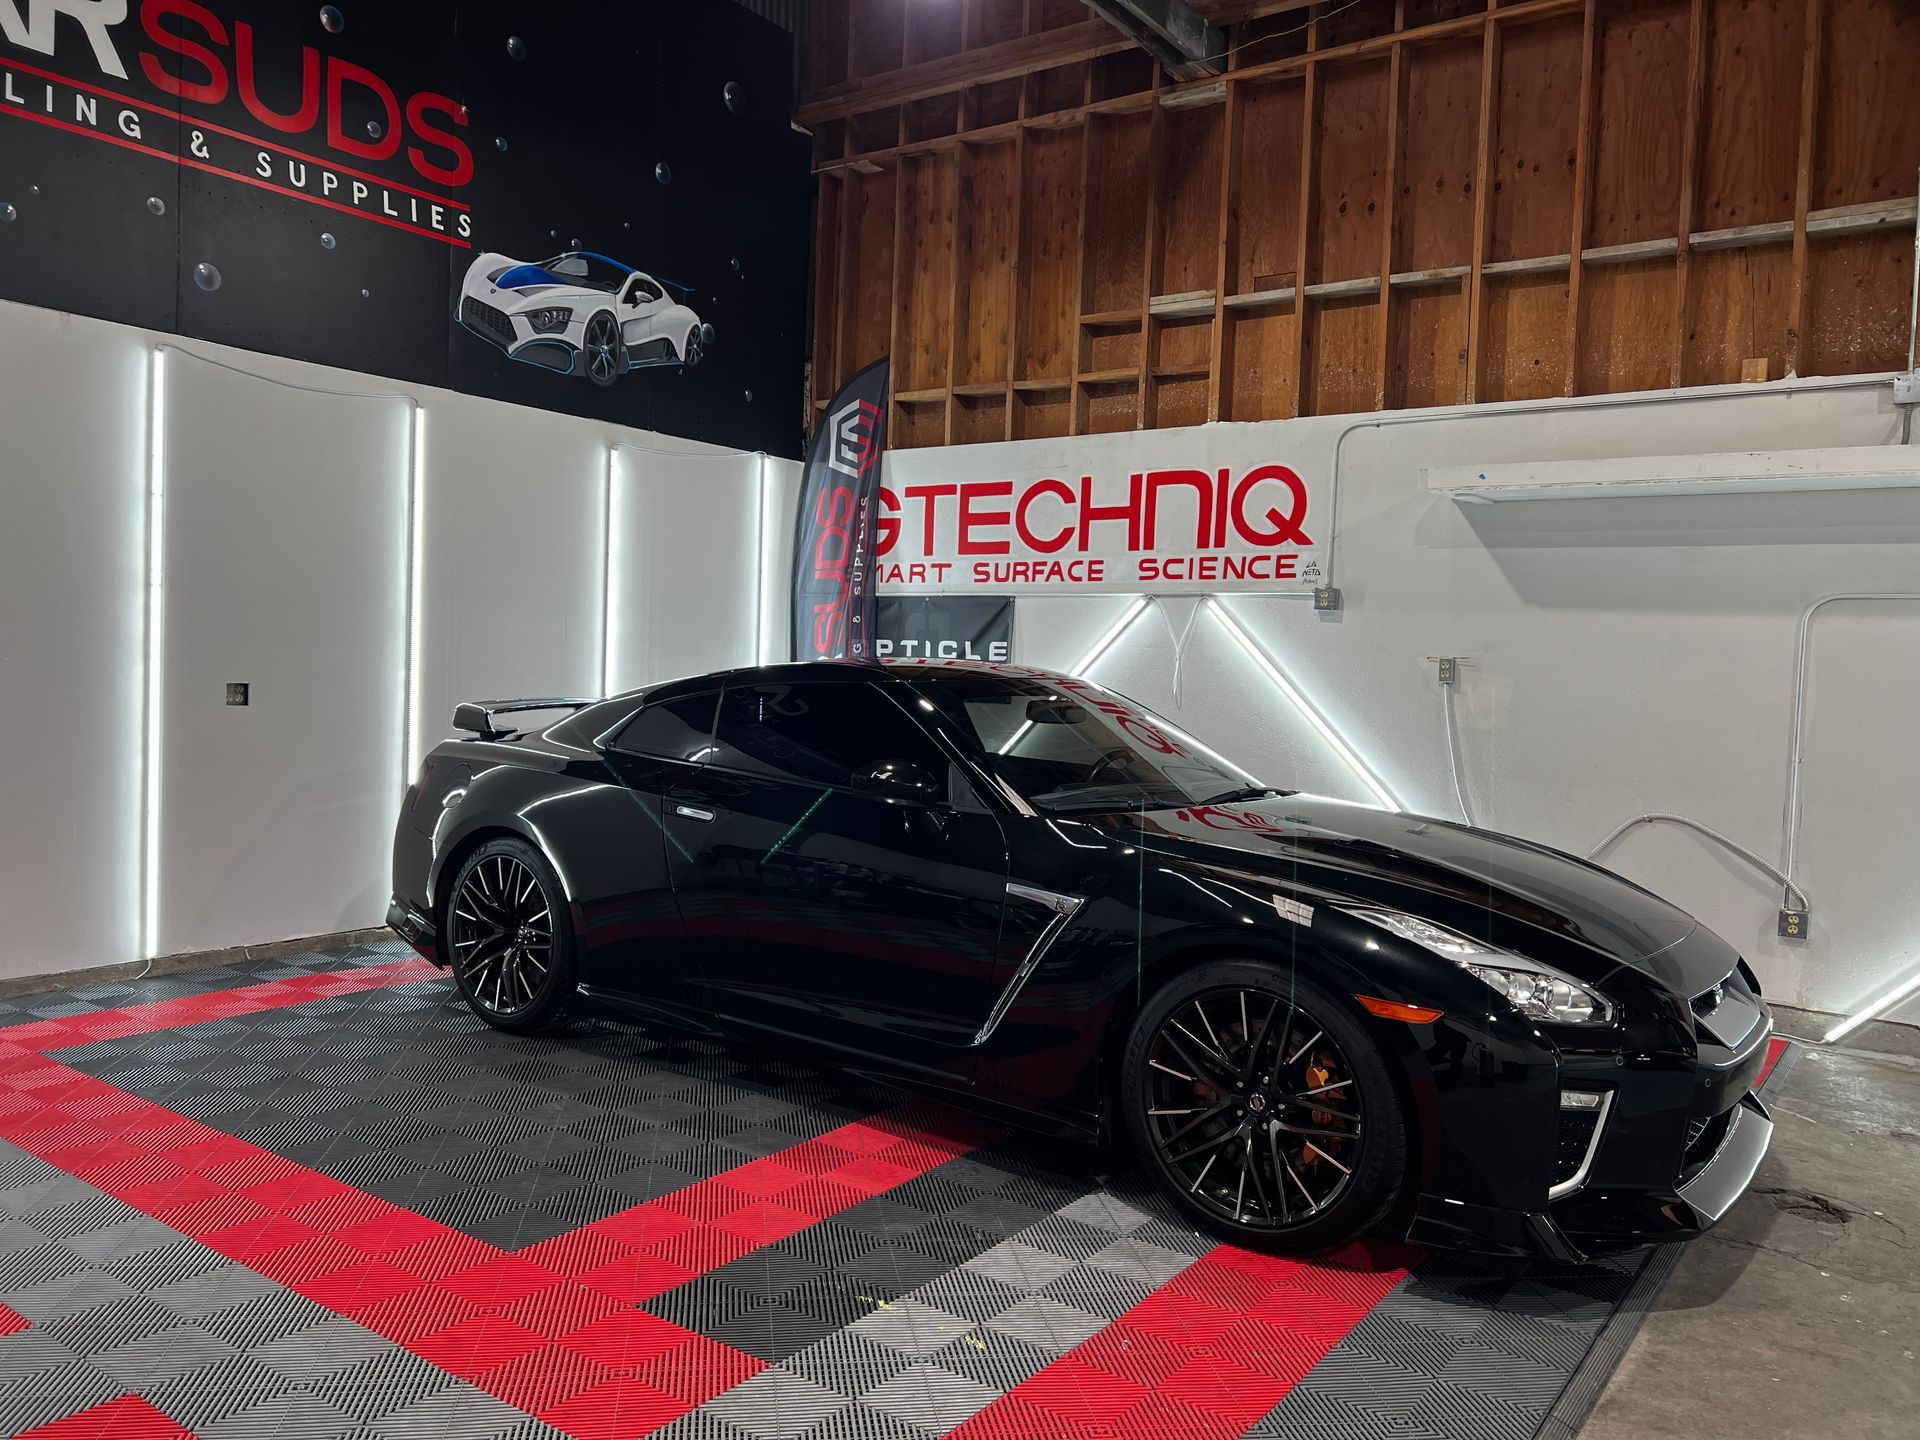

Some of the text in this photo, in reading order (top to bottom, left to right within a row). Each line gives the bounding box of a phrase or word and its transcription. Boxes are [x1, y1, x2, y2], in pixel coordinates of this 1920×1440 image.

[6, 72, 472, 238] LING & SUPPLIES
[814, 486, 853, 653] SUDS
[972, 559, 1104, 584] SURFACE
[1138, 554, 1299, 581] SCIENCE
[852, 615, 861, 623] &
